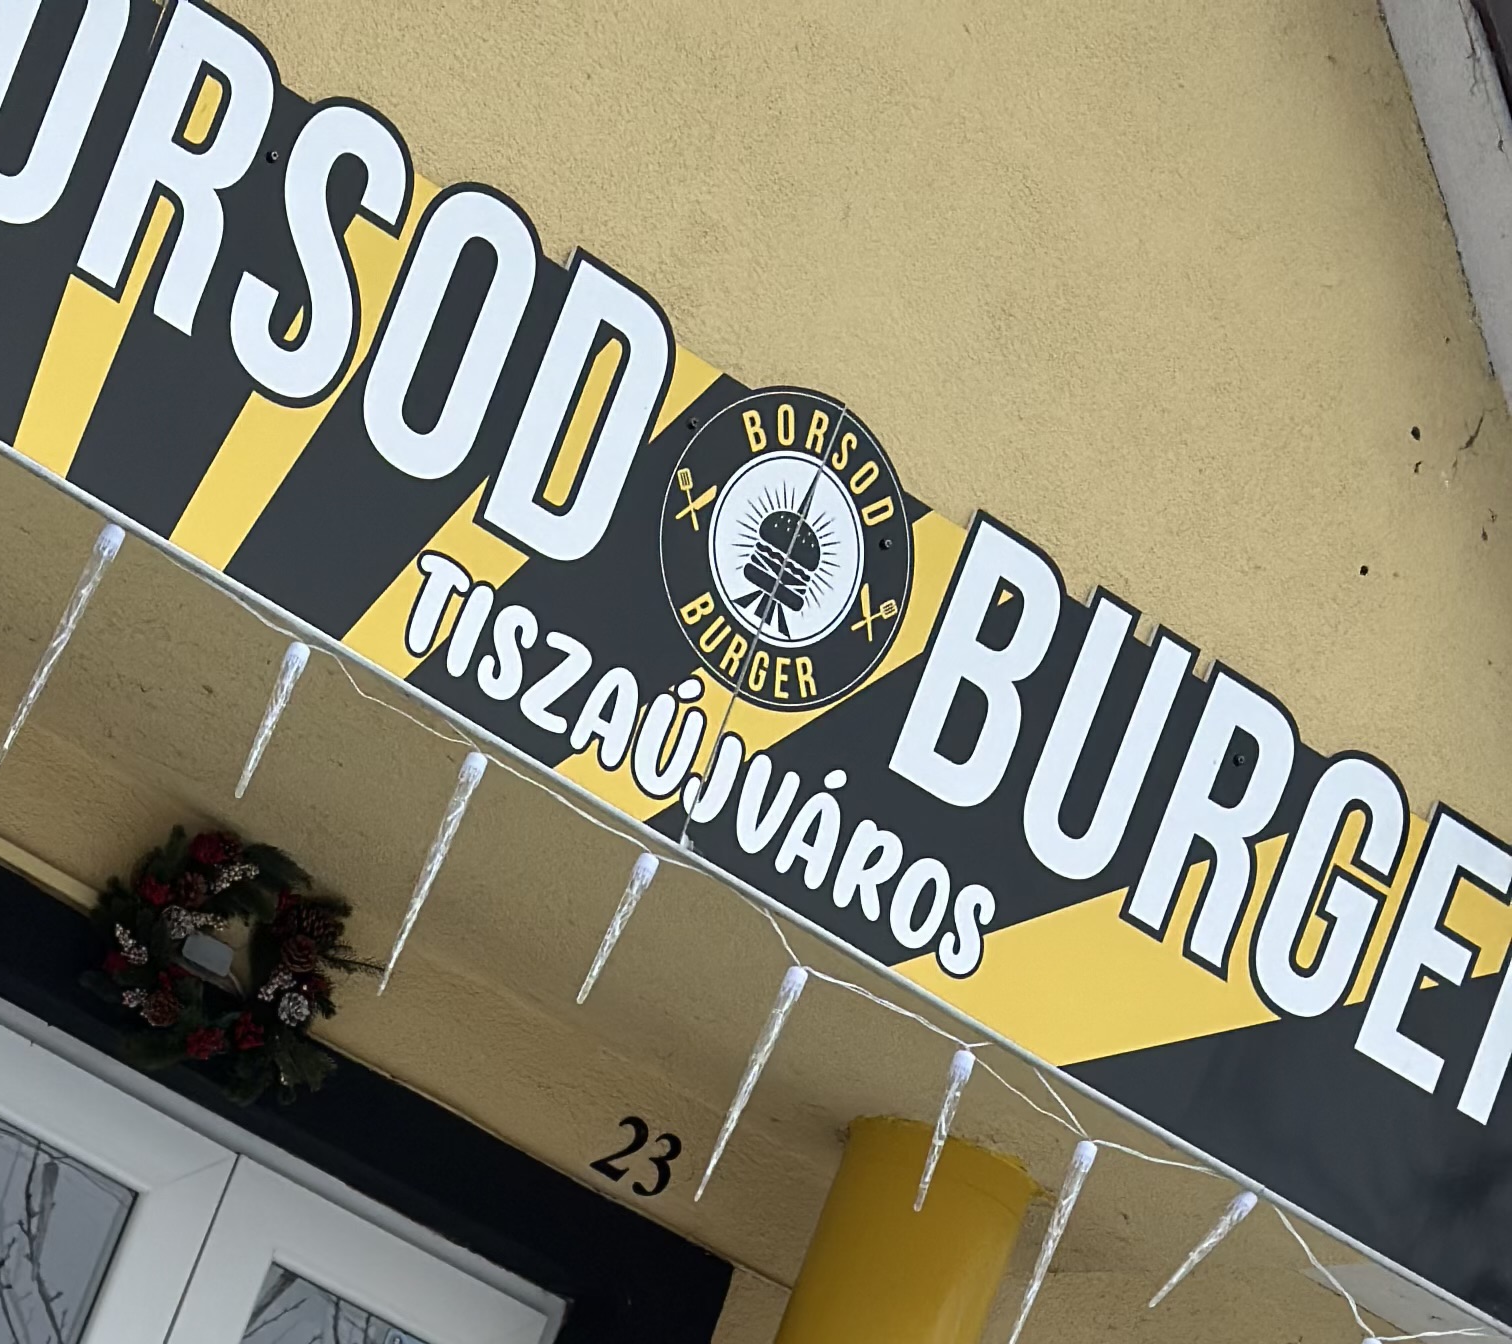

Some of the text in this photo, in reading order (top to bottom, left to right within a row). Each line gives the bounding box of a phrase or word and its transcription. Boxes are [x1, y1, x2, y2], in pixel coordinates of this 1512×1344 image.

[741, 403, 895, 527] BORSOD
[679, 590, 818, 700] BURGER
[409, 553, 996, 977] TISZAÚJVÁROS
[589, 1115, 682, 1197] 23
